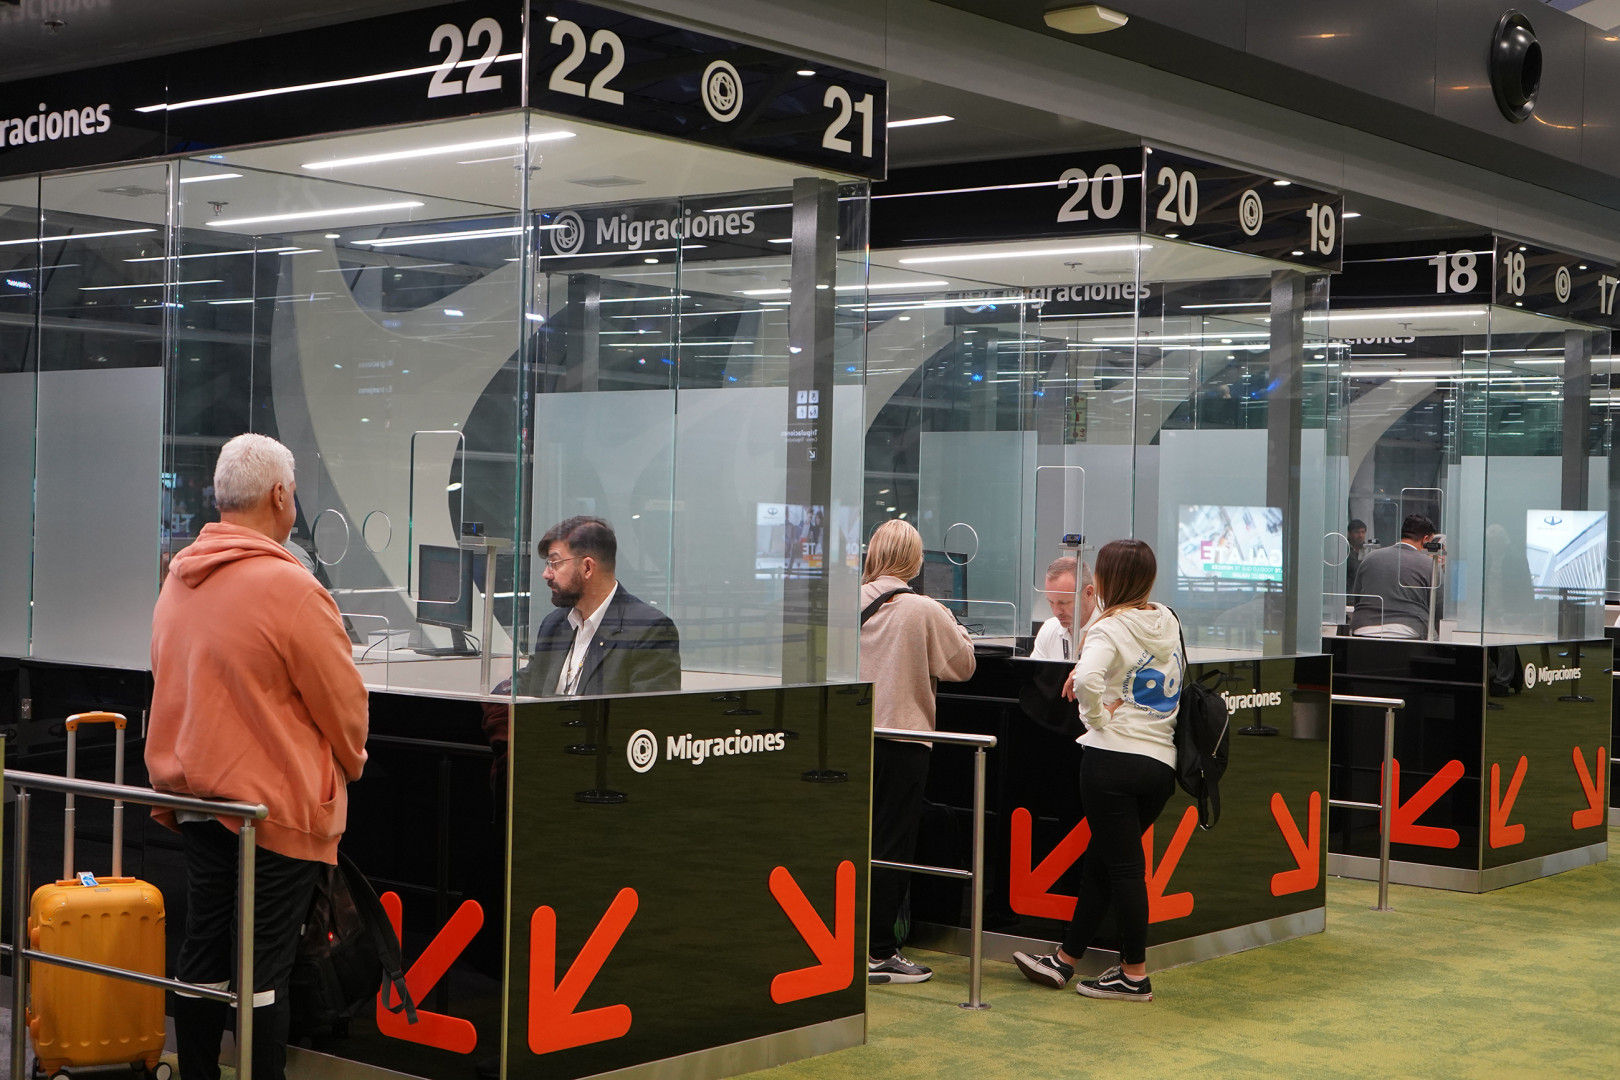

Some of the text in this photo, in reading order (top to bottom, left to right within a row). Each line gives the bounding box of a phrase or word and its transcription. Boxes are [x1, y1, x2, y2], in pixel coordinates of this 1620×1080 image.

[427, 17, 503, 98] 22
[548, 19, 625, 106] 22
[822, 85, 874, 158] 21
[1056, 163, 1124, 223] 20
[1156, 166, 1198, 226] 20
[596, 208, 755, 250] Migraciones
[1306, 202, 1336, 256] 19
[1428, 249, 1478, 294] 18
[1503, 251, 1526, 297] 18
[1597, 274, 1618, 315] 17
[1537, 664, 1582, 686] Migraciones
[666, 728, 786, 766] Migraciones
